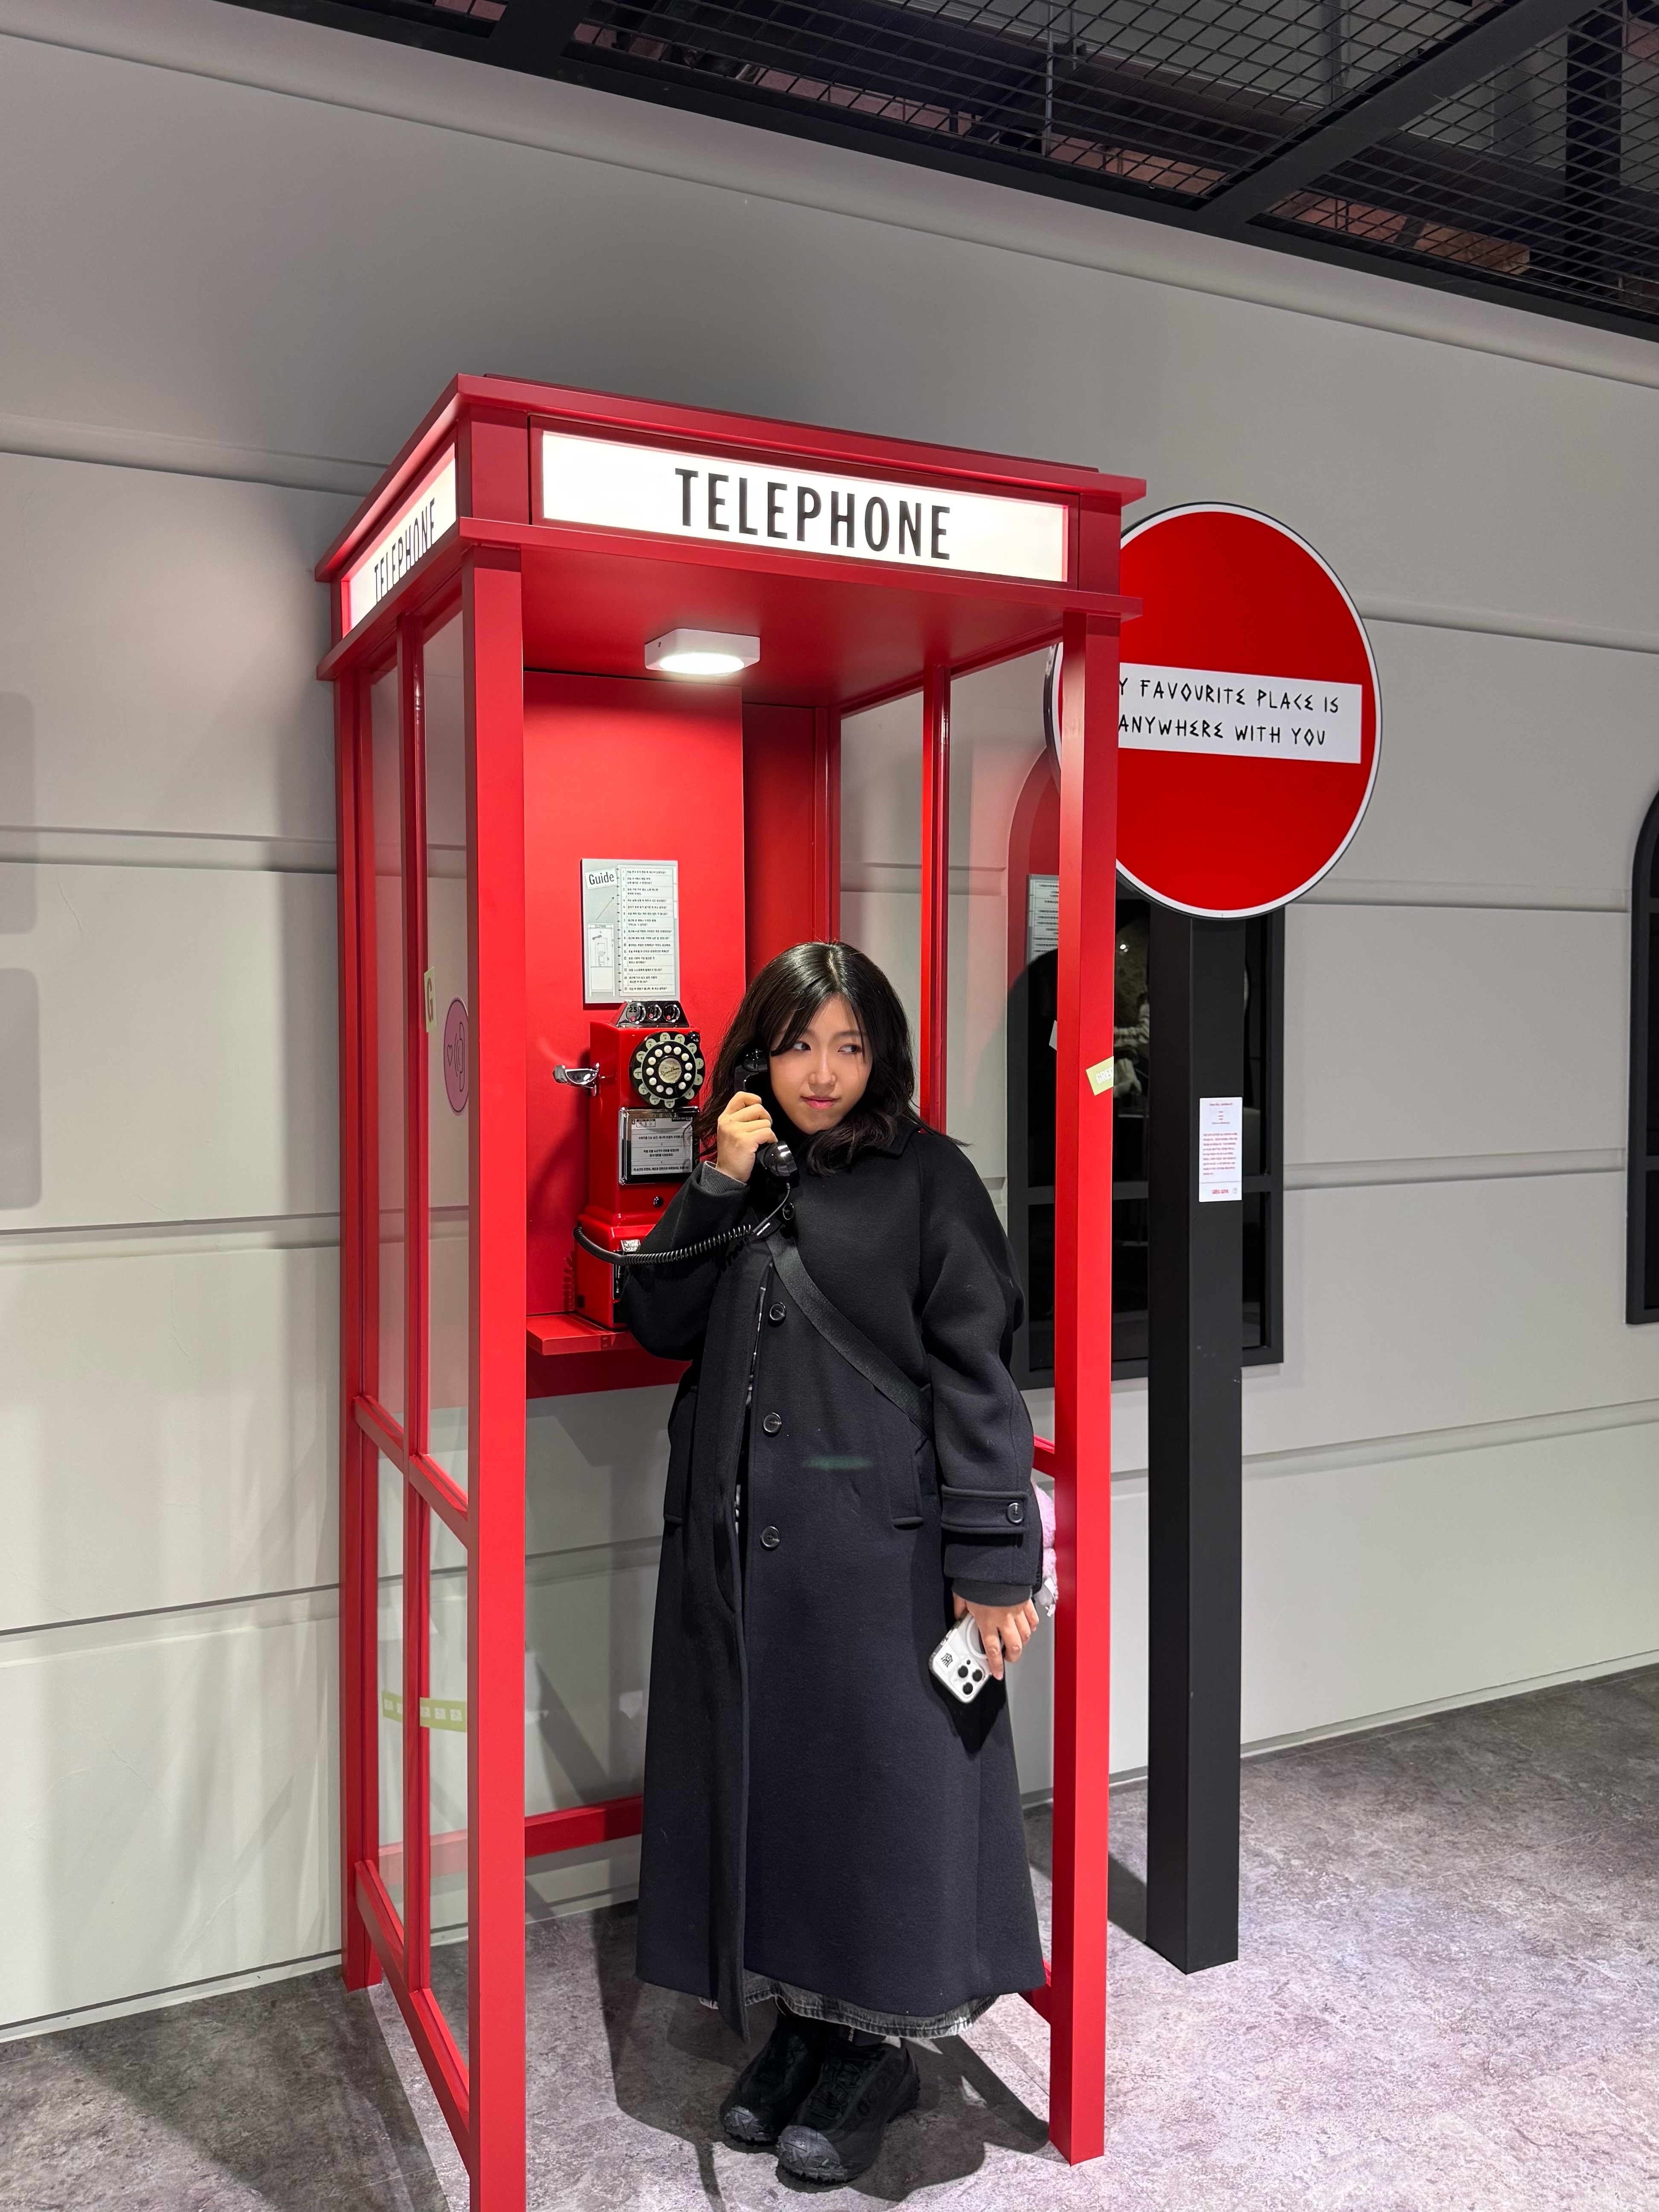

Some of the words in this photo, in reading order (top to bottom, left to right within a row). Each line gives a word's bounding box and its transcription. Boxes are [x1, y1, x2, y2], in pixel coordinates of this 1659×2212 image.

[675, 468, 950, 560] TELEPHONE
[374, 497, 435, 605] TELEPHONE
[1140, 679, 1245, 705] FAVOURITE
[1257, 689, 1313, 711] PLACE
[1325, 697, 1338, 713] IS
[1119, 714, 1224, 738] ANYWHERE
[1235, 725, 1280, 743] WITH
[1291, 727, 1325, 746] YOU
[589, 872, 615, 885] Guide
[427, 978, 433, 1023] G
